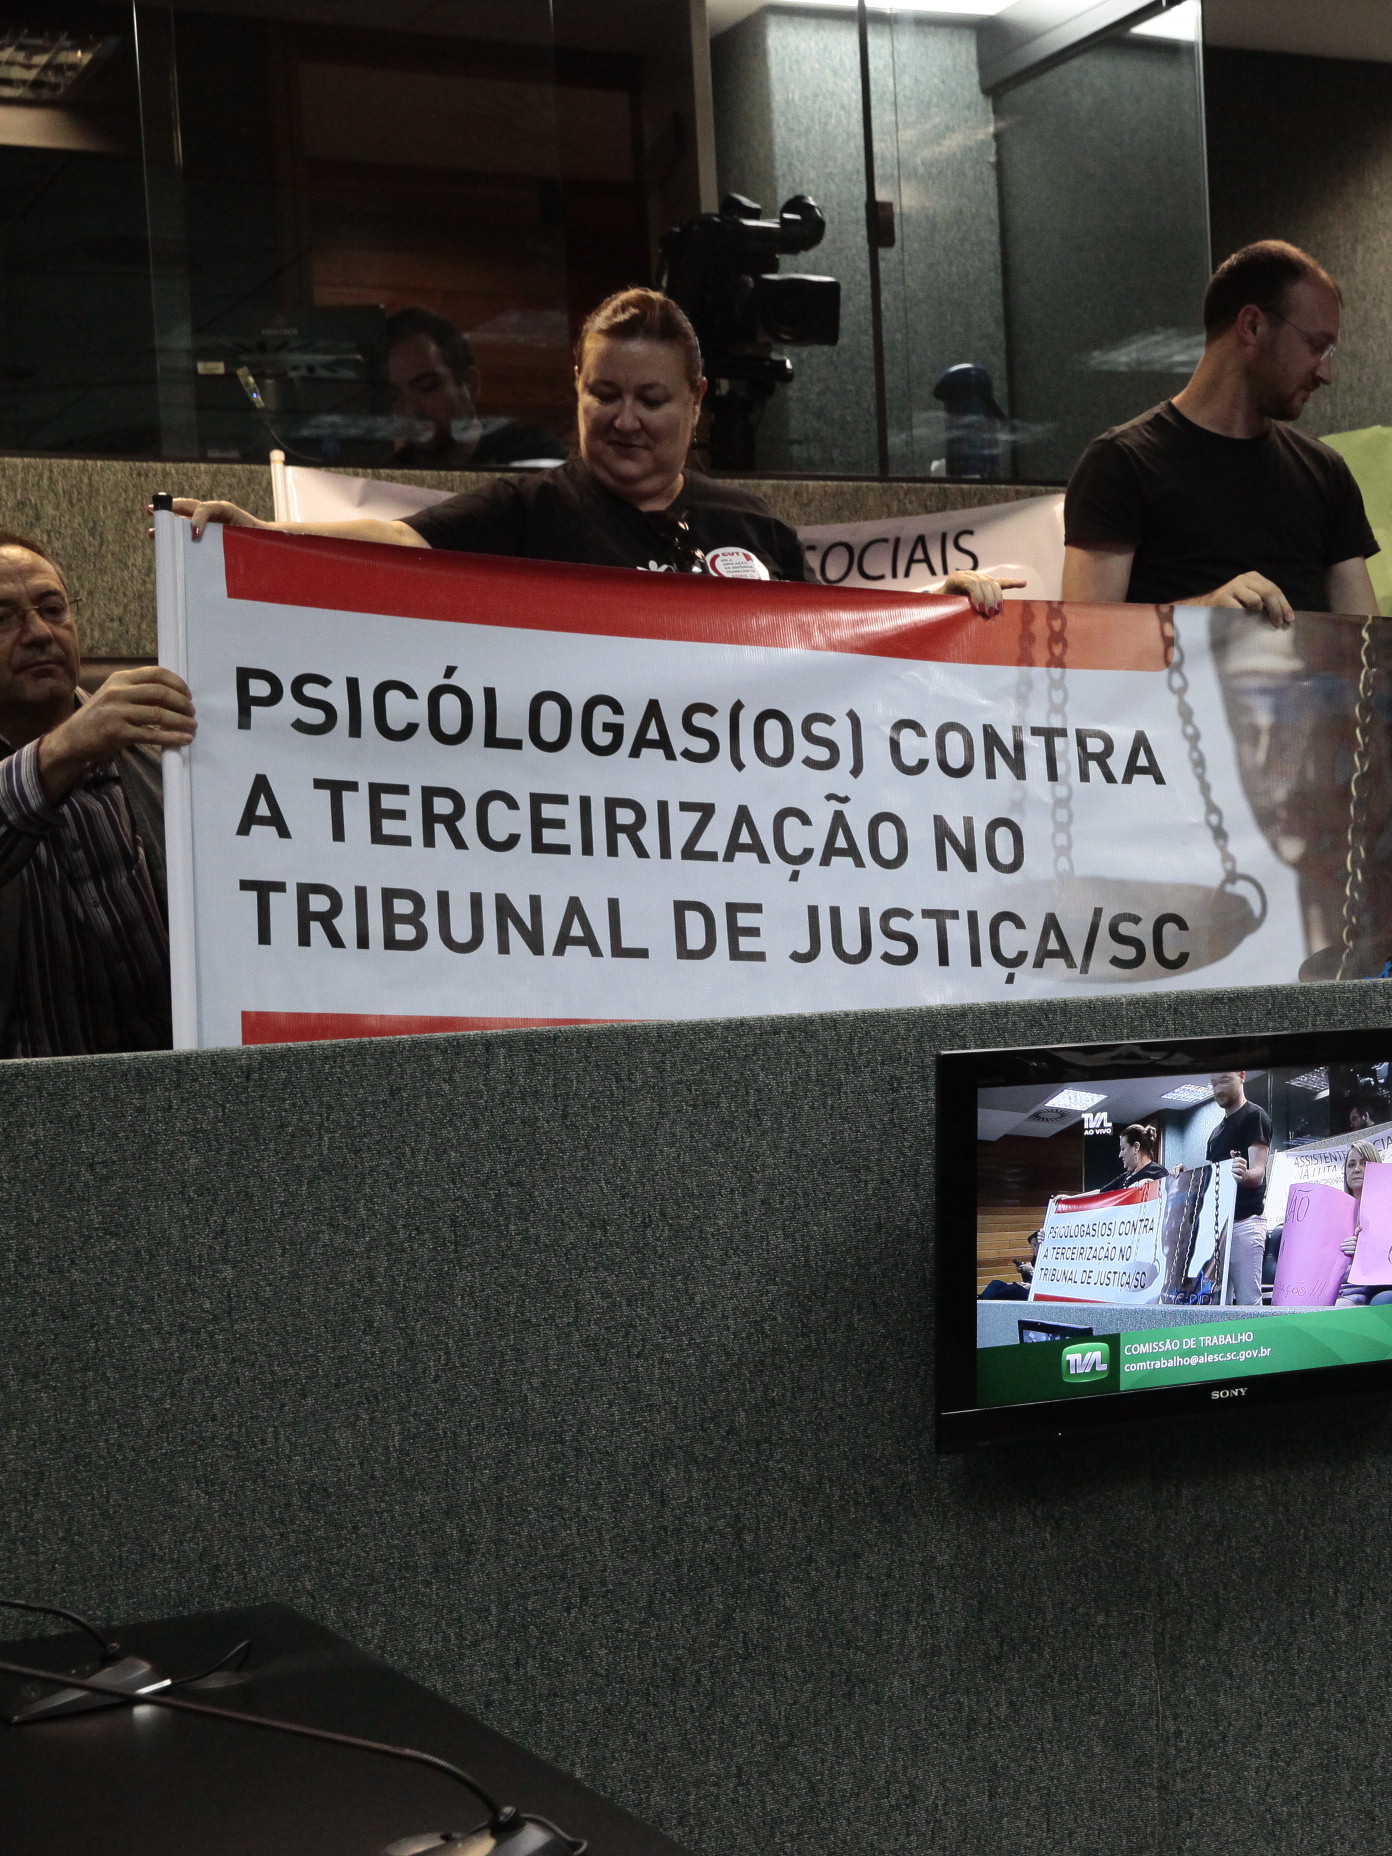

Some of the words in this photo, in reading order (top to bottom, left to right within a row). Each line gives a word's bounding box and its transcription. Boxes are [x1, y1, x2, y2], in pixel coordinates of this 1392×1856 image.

[806, 529, 980, 585] OCIAIS
[235, 665, 864, 779] PSICÓLOGAS(OS)
[888, 718, 1166, 786] CONTRA
[235, 774, 292, 839] A
[313, 777, 908, 882] TERCEIRIZAÇÃO
[933, 814, 1025, 874] NO
[239, 878, 649, 960] TRIBUNAL
[672, 899, 767, 963] DE
[788, 904, 1191, 985] JUSTIÇA/SC
[1048, 1219, 1116, 1240] PSICÓLOGAS(OS)
[1117, 1217, 1155, 1237] CONTRA
[1043, 1246, 1049, 1261] A
[1050, 1242, 1117, 1266] TERCEIRIZAÇÃO
[1117, 1246, 1132, 1262] NO
[1038, 1267, 1079, 1285] TRIBUNAL
[1080, 1269, 1094, 1286] DE
[1093, 1270, 1147, 1292] JUSTIÇA/SC
[1124, 1338, 1181, 1356] COMISSÃO
[1182, 1337, 1197, 1350] DE
[1199, 1331, 1255, 1348] TRABALHO
[1124, 1345, 1273, 1373] comtrabalho@alesc.sc.gov.br
[1210, 1386, 1249, 1400] SONY
